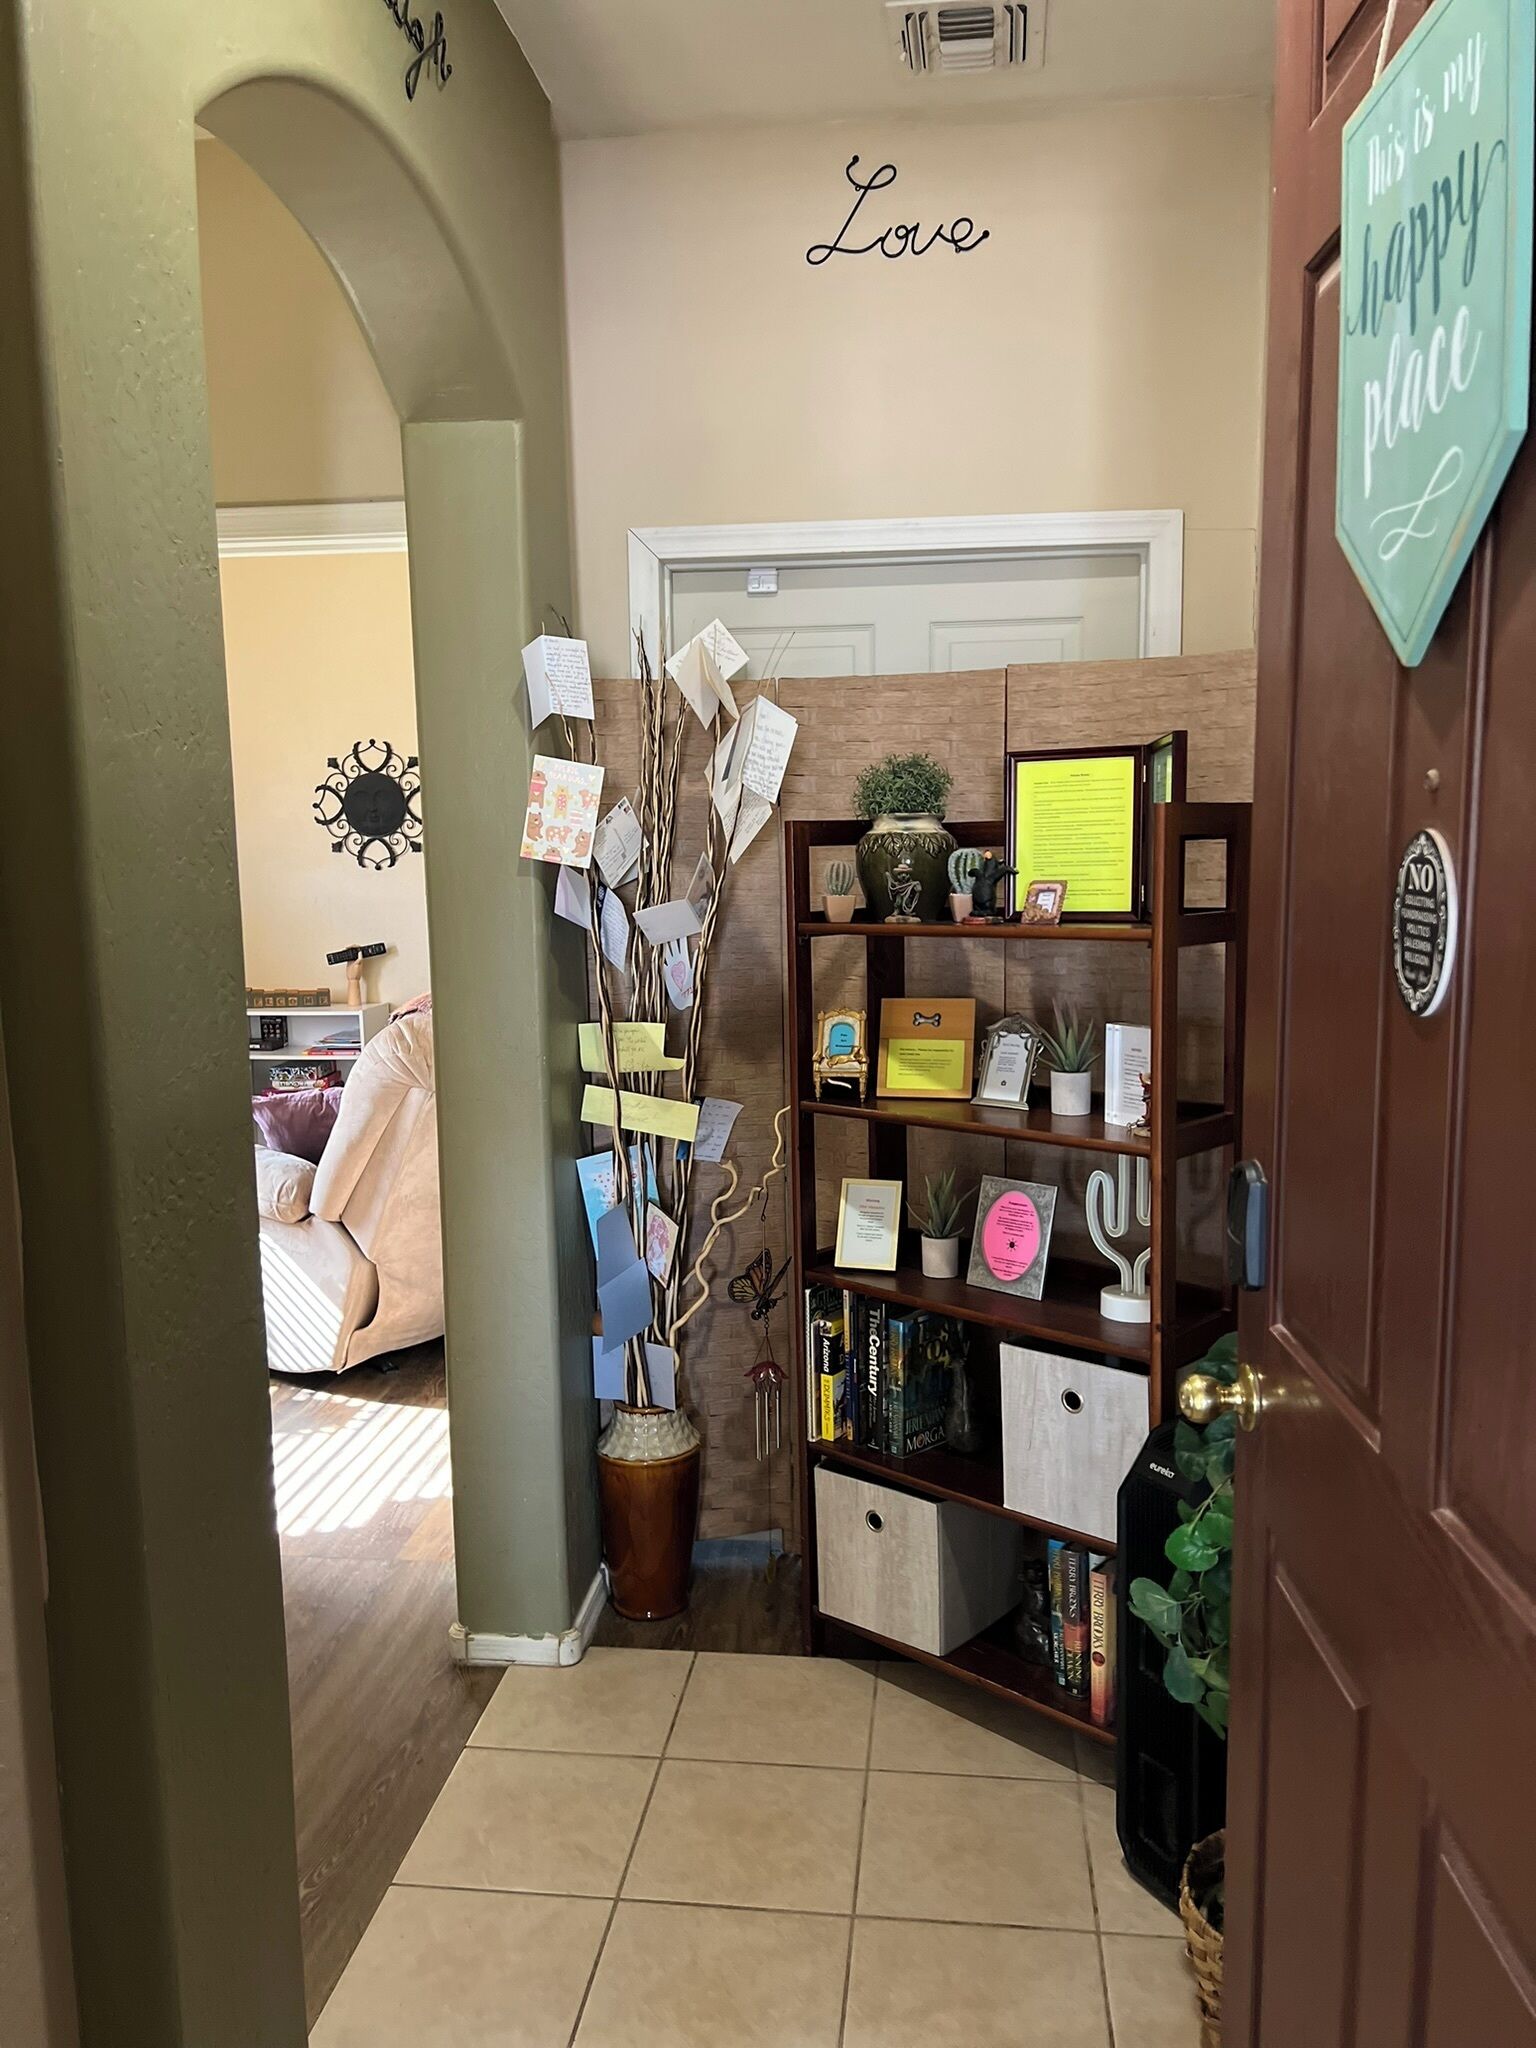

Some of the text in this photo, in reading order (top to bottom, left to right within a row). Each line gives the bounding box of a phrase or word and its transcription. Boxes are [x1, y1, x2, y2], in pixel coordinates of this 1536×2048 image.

[1367, 32, 1488, 206] This is my
[806, 154, 990, 266] Love
[1346, 139, 1506, 338] happy
[1362, 304, 1484, 499] place
[1408, 862, 1435, 893] NO
[1403, 936, 1432, 952] SALESMEN
[1406, 922, 1431, 938] POLITICS
[1403, 950, 1430, 967] RELIGION
[822, 1337, 831, 1373] Arizona
[1149, 1462, 1175, 1479] eureka
[1093, 1611, 1104, 1649] BROOKS
